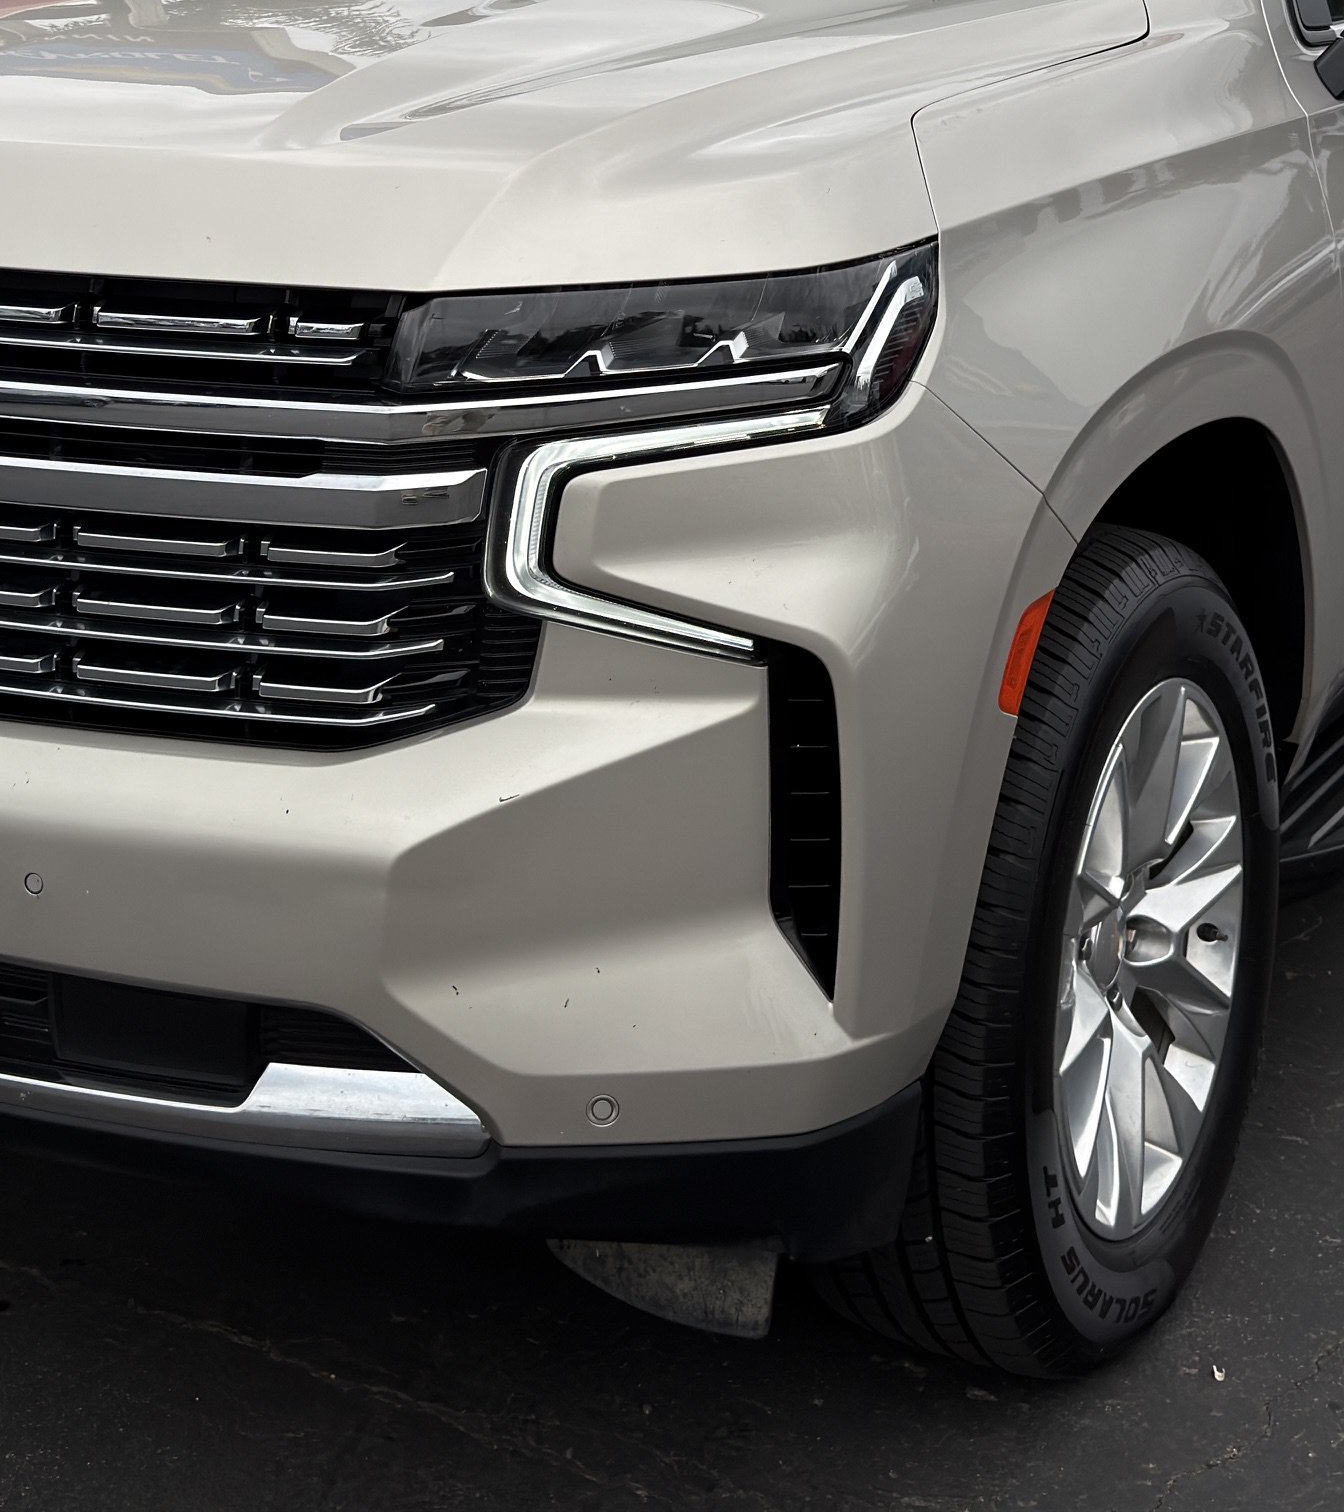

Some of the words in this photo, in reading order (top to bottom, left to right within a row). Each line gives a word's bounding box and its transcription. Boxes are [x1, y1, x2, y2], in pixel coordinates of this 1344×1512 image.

[1206, 611, 1276, 783] STARFIRE
[1042, 1165, 1066, 1229] HT
[1060, 1245, 1157, 1324] SOLARUS
